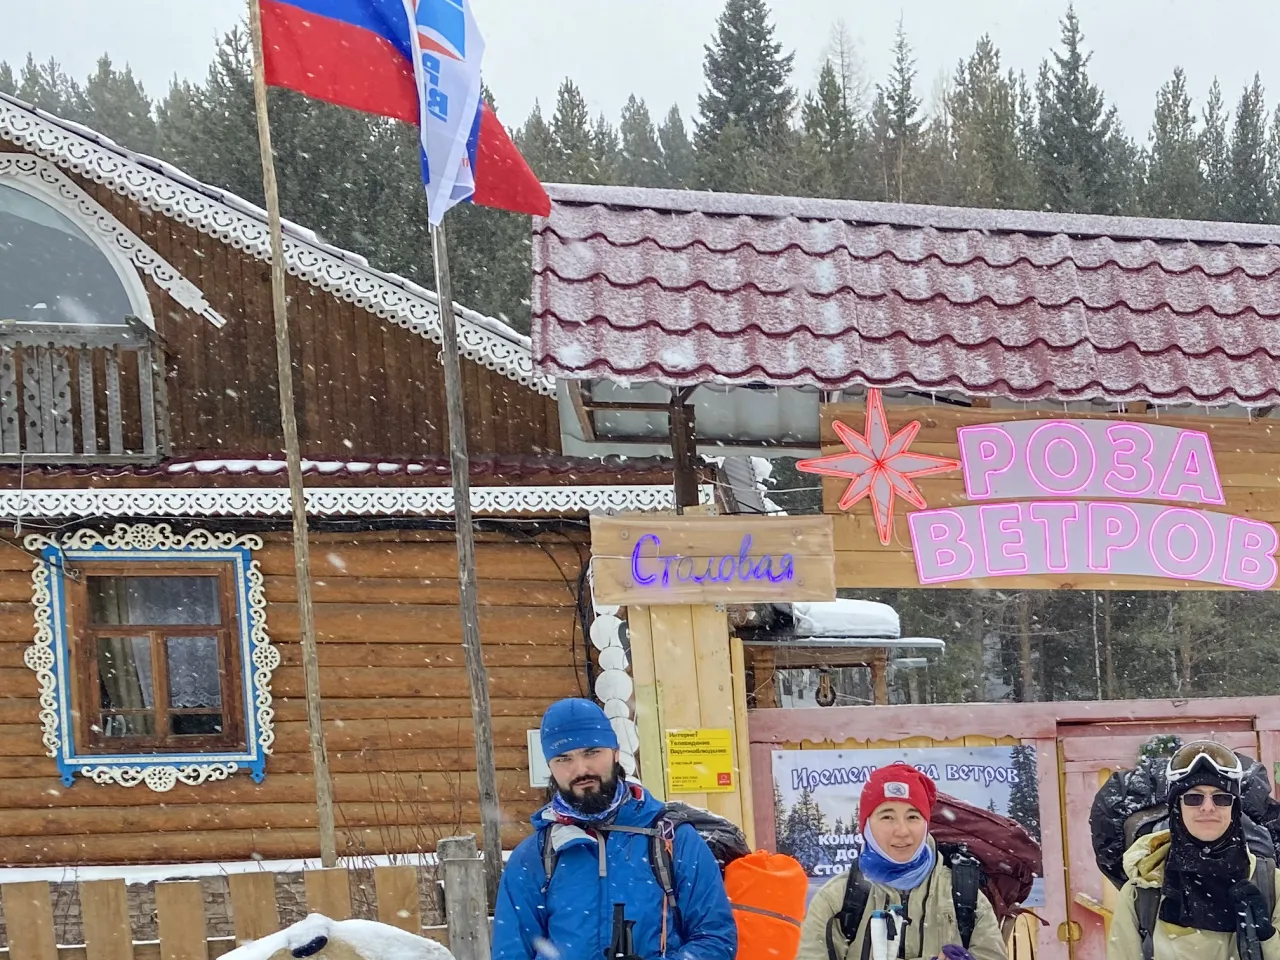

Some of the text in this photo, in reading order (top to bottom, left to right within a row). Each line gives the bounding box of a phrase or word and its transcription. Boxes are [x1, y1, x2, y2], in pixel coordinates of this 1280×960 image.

[957, 420, 1226, 505] РОЗА
[630, 533, 794, 586] Столовая
[907, 501, 1280, 591] ВЕТРОВ
[791, 765, 877, 792] Иремел
[945, 763, 1020, 787] ветров
